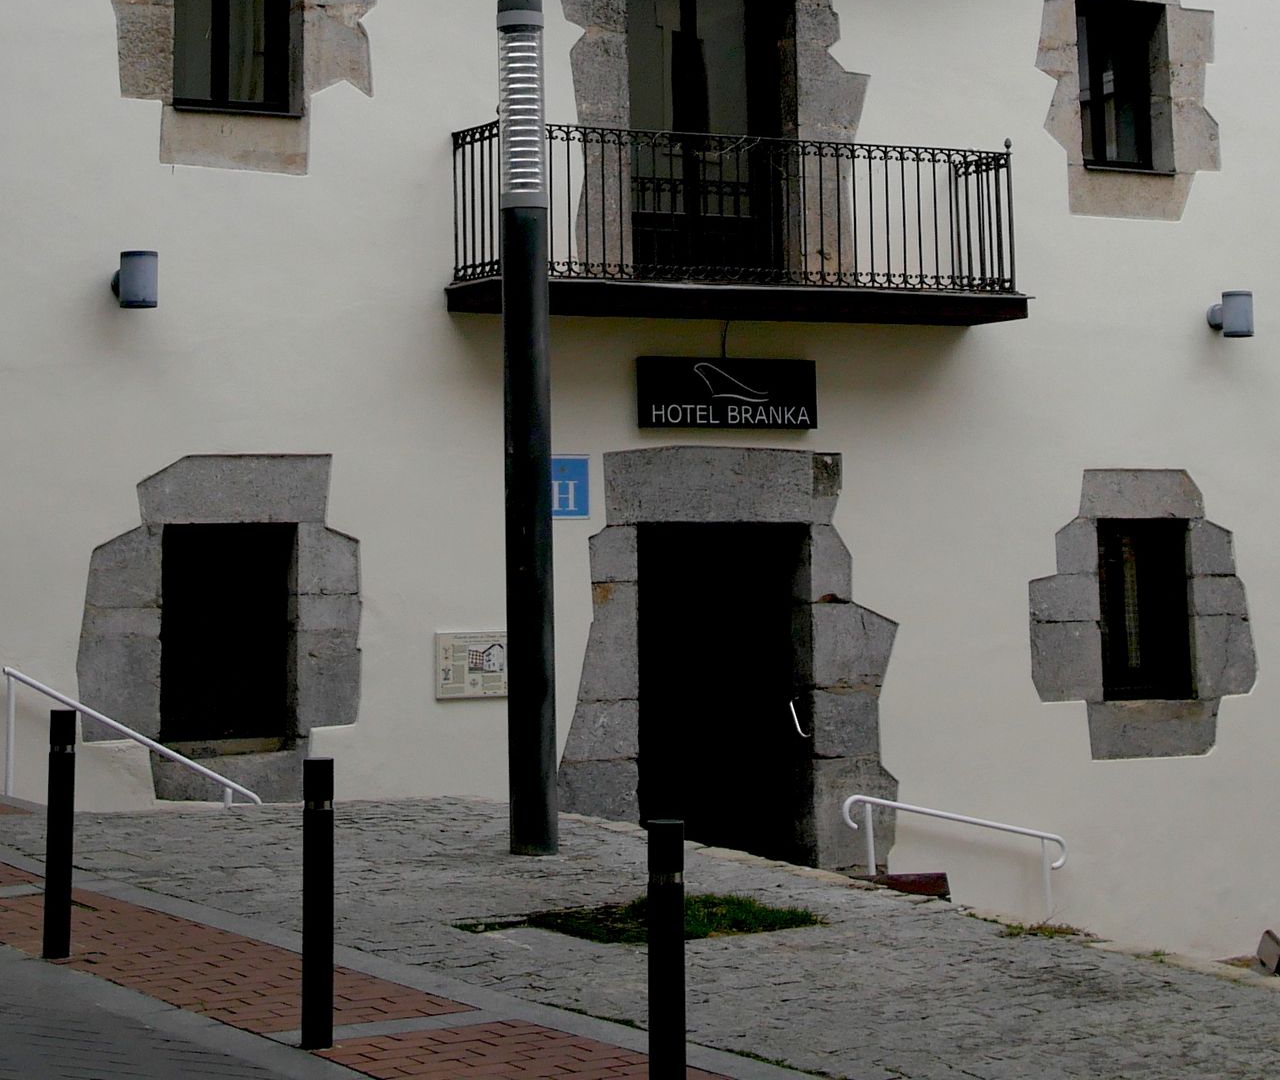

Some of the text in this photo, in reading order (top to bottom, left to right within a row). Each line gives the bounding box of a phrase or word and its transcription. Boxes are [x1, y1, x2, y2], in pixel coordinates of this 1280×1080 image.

[651, 404, 811, 425] HOTEL BRANKA
[551, 480, 579, 511] H
